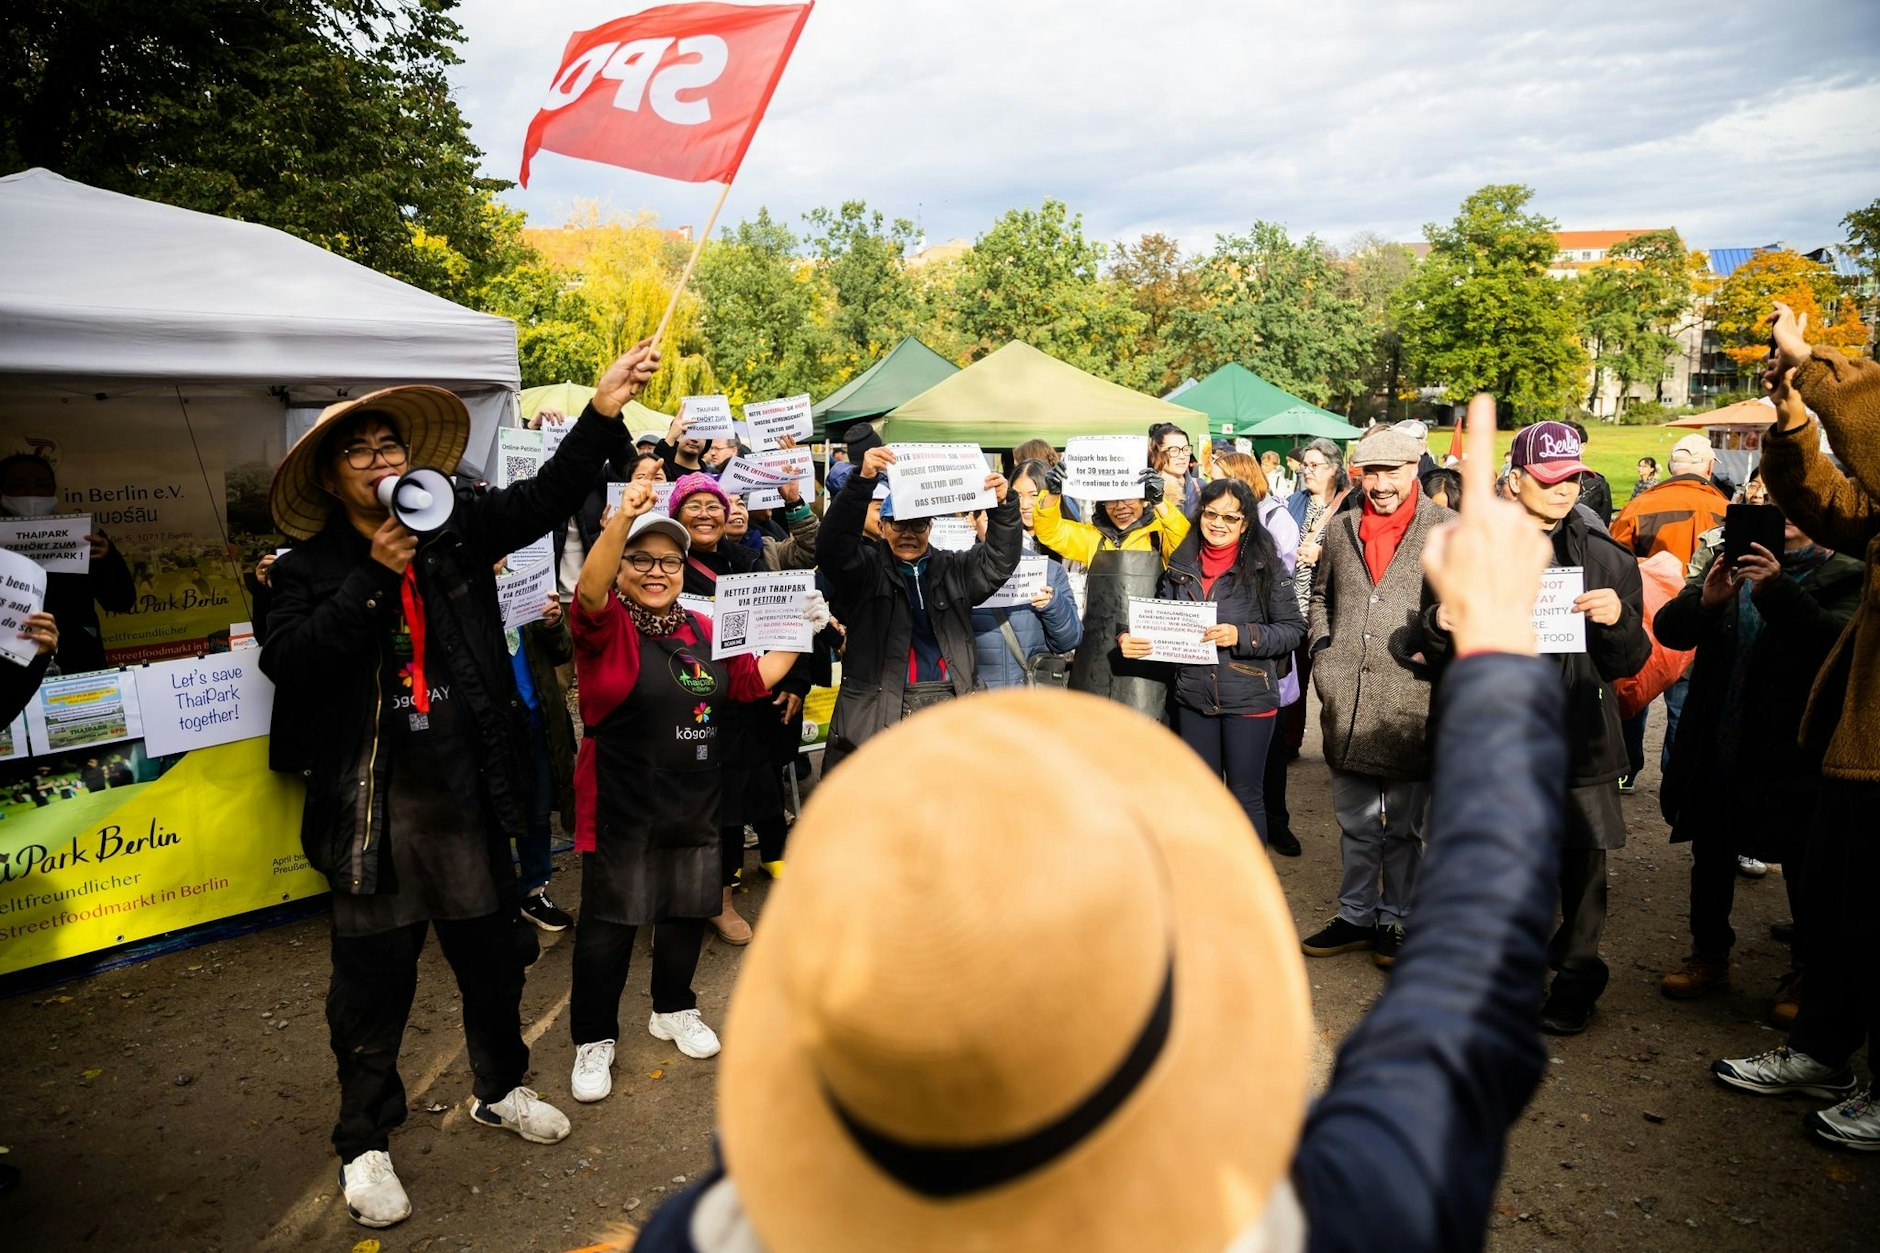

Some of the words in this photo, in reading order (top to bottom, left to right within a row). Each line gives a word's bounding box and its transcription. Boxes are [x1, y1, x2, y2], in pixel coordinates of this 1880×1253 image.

[1539, 429, 1580, 458] Berlin
[1096, 454, 1107, 462] has
[734, 460, 750, 471] BITTE
[900, 466, 926, 476] UNSERE
[1076, 467, 1086, 475] for
[1087, 467, 1097, 475] 30
[1098, 468, 1116, 476] years
[1117, 467, 1129, 475] and
[920, 479, 948, 490] KULTUR
[949, 477, 963, 487] UND
[1082, 479, 1110, 487] continue
[1112, 479, 1119, 487] to
[1120, 479, 1129, 487] do
[65, 488, 82, 503] in
[89, 485, 148, 502] Berlin
[154, 484, 184, 500] e.V.
[915, 498, 929, 508] DAS
[931, 492, 976, 506] STREET-FOOD
[16, 529, 69, 540] THAIPARK
[168, 531, 193, 540] Berlin
[50, 541, 77, 550] ZUM
[5, 575, 30, 593] been
[724, 587, 750, 598] RETTET
[752, 585, 766, 595] DEN
[769, 583, 807, 593] THAIPARK
[180, 586, 228, 611] Berlin
[738, 598, 750, 606] VIA
[753, 595, 787, 606] PETITION
[8, 600, 31, 614] and
[1, 617, 17, 629] do
[171, 668, 207, 689] Let's
[212, 667, 243, 683] save
[174, 683, 241, 710] ThaiPark
[179, 703, 239, 732] together!
[95, 816, 182, 863] Berlin
[161, 888, 176, 903] in
[180, 876, 229, 898] Berlin
